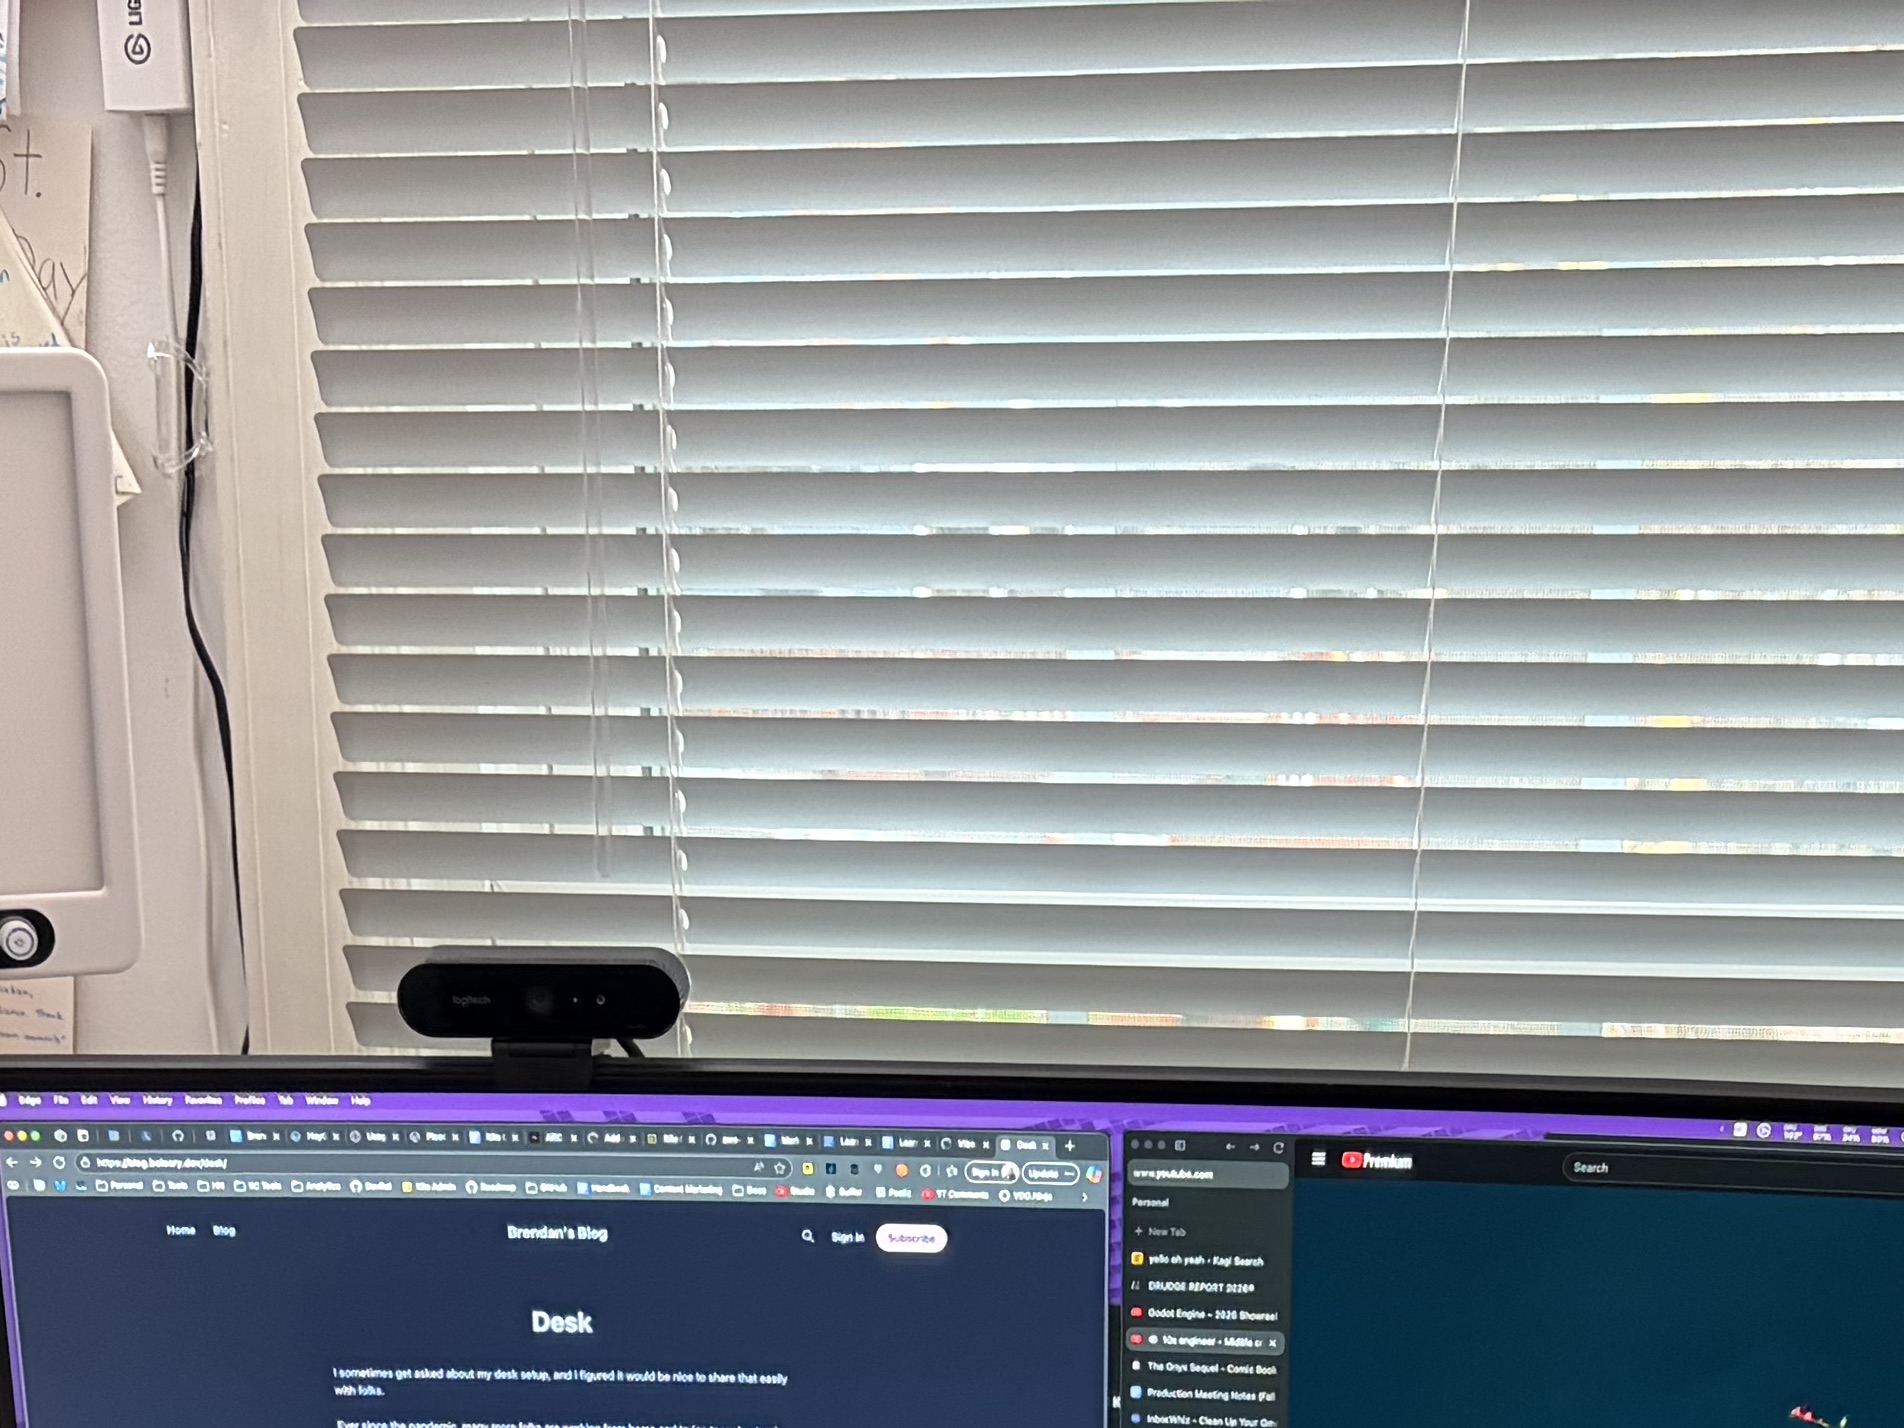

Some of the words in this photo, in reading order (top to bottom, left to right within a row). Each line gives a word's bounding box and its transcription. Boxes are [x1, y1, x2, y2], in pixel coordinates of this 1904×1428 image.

[1362, 1152, 1412, 1169] Premium
[1574, 1161, 1608, 1173] Search
[1132, 1197, 1169, 1207] Personal
[166, 1225, 195, 1235] Home
[212, 1224, 235, 1237] Blog
[507, 1225, 575, 1239] Brendan's
[577, 1225, 608, 1242] Blog
[1148, 1227, 1167, 1236] New
[1170, 1227, 1186, 1236] Tab
[888, 1233, 934, 1243] Subscribe
[531, 1310, 593, 1333] Desk
[332, 1367, 336, 1377] I
[338, 1367, 393, 1378] sometimes
[395, 1368, 412, 1380] get
[414, 1367, 443, 1379] asked
[445, 1368, 474, 1379] about
[476, 1370, 492, 1380] my
[493, 1368, 518, 1379] desk
[520, 1369, 550, 1381] setup,
[553, 1369, 572, 1380] and
[573, 1369, 577, 1379] I
[579, 1369, 614, 1382] figured
[616, 1369, 623, 1380] it
[625, 1370, 655, 1381] would
[657, 1370, 670, 1382] be
[672, 1371, 693, 1382] nice
[695, 1371, 706, 1382] to
[708, 1371, 735, 1382] share
[737, 1372, 757, 1383] that
[759, 1373, 787, 1385] easily
[334, 1384, 356, 1395] with
